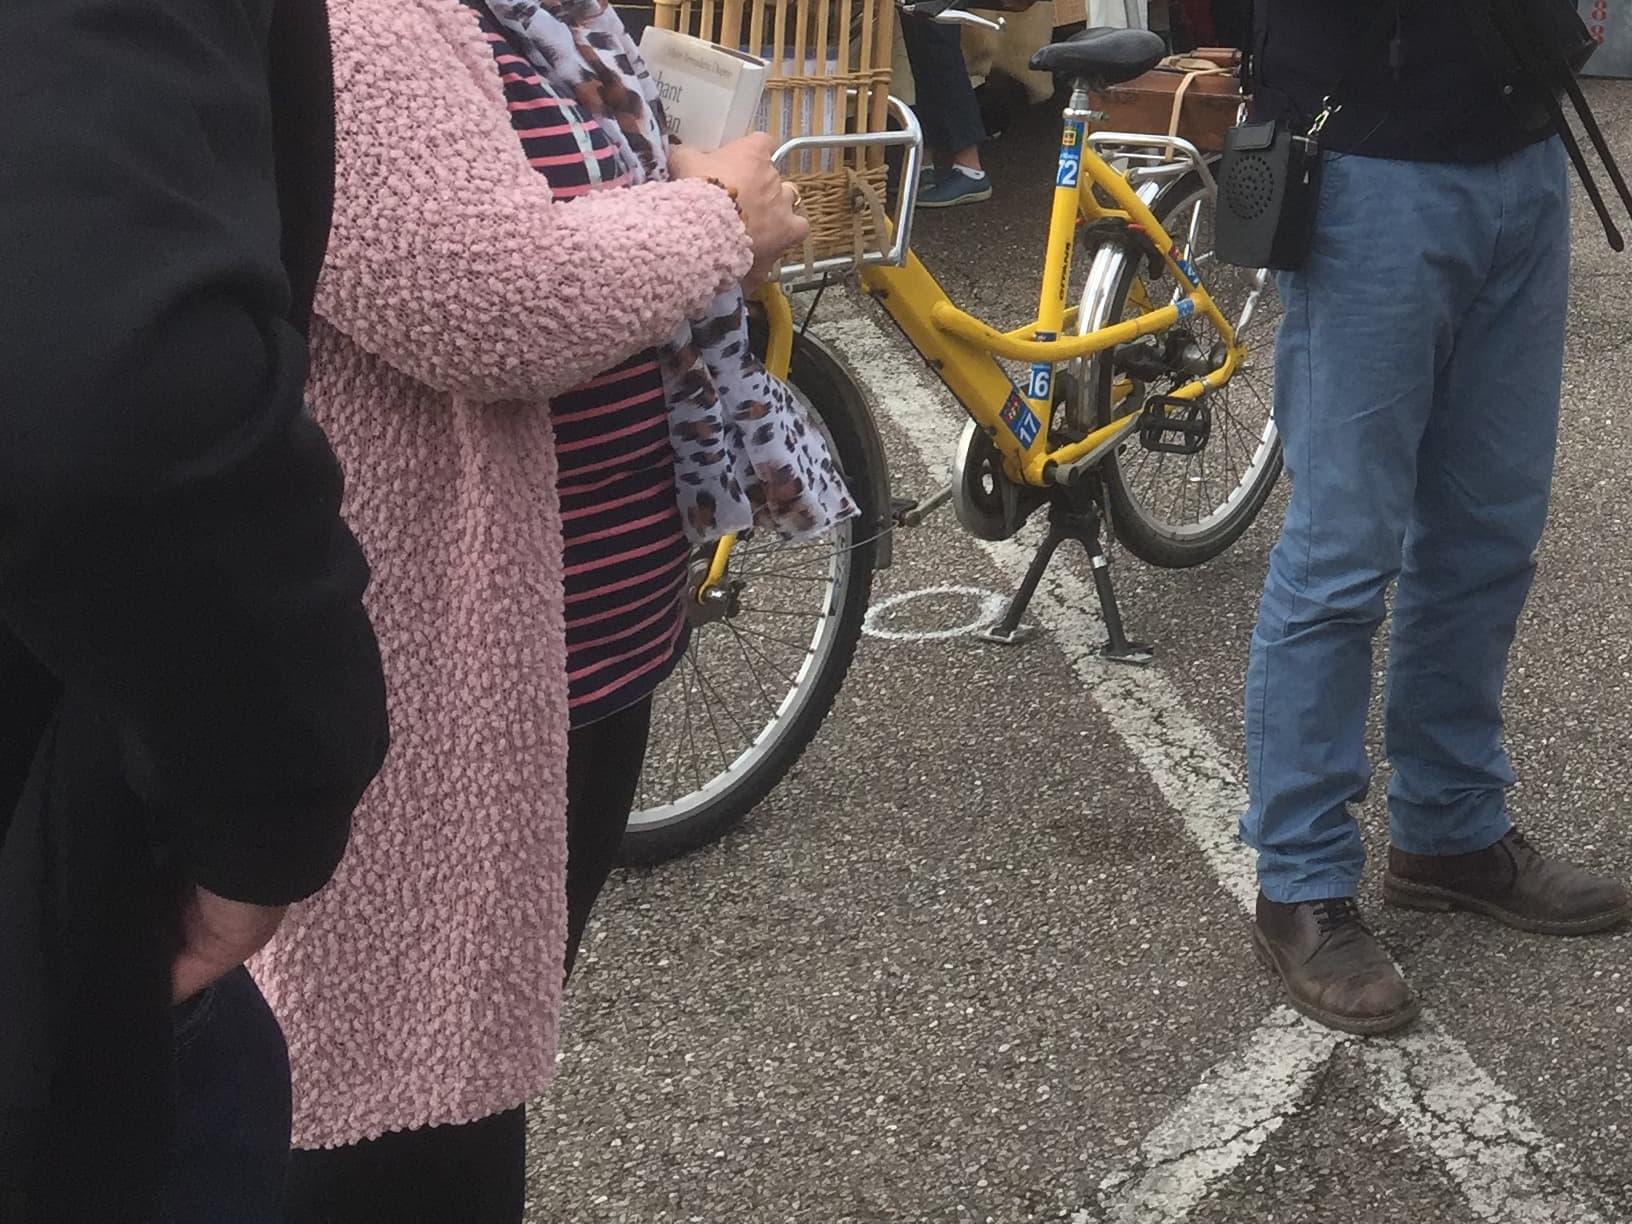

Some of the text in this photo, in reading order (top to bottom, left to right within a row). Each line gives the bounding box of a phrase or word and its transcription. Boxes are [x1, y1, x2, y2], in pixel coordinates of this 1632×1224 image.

[654, 71, 682, 104] hant
[1028, 369, 1050, 397] 16
[1019, 411, 1038, 444] 17
